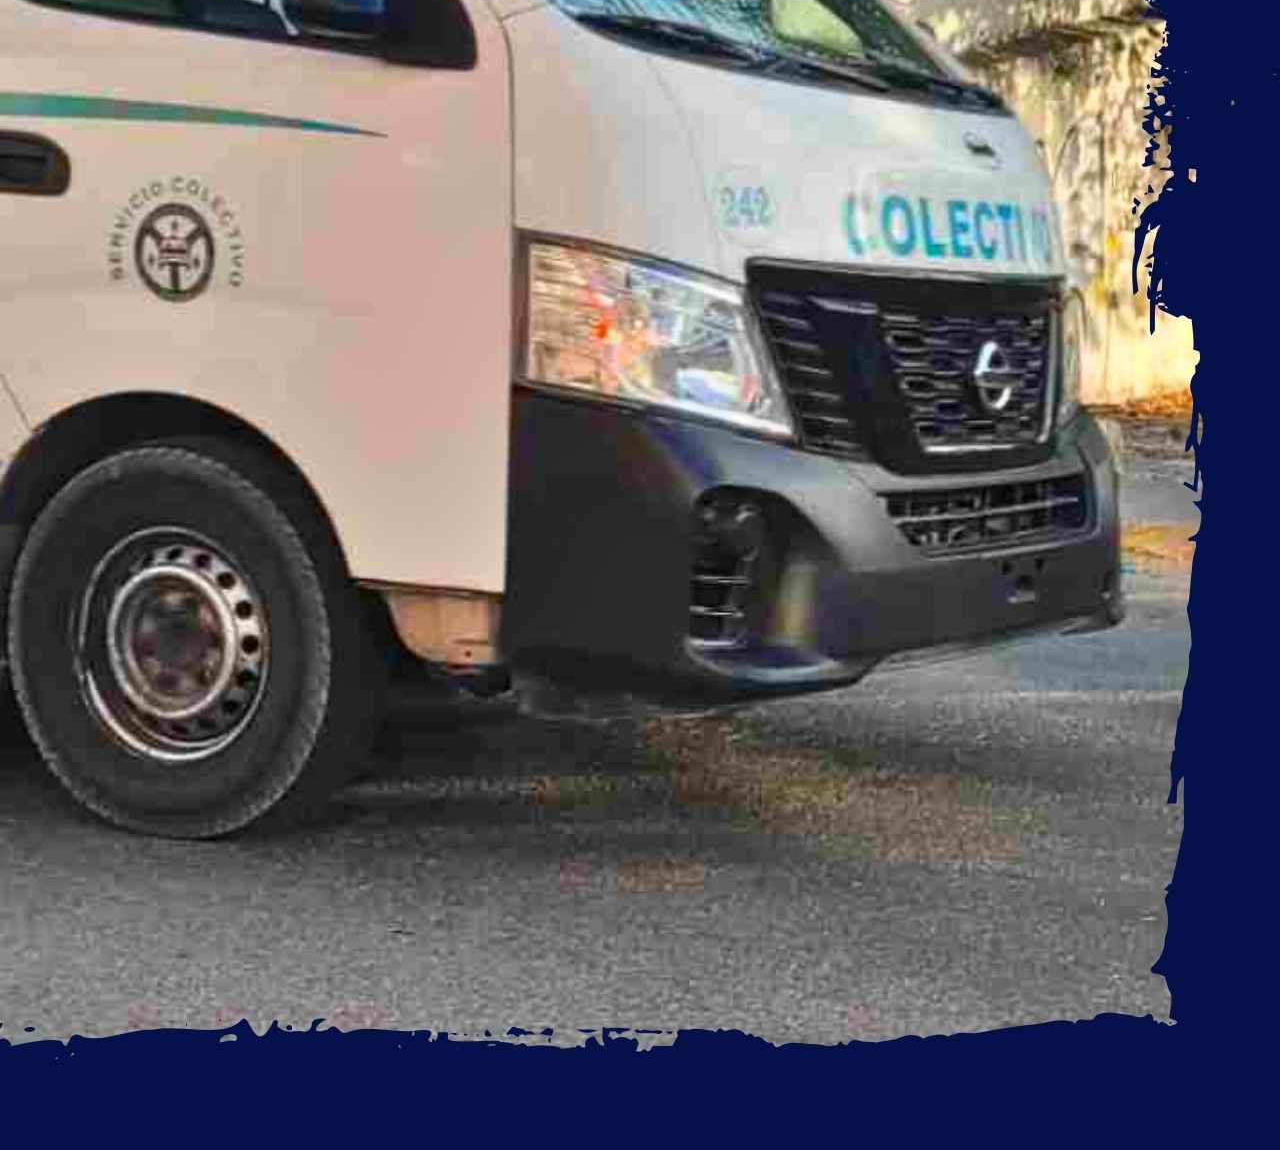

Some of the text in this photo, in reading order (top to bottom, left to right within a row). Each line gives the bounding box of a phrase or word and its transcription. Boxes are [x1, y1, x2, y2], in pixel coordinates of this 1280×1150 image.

[108, 175, 245, 288] SERVICIO COLECTIVO
[719, 186, 769, 228] 242
